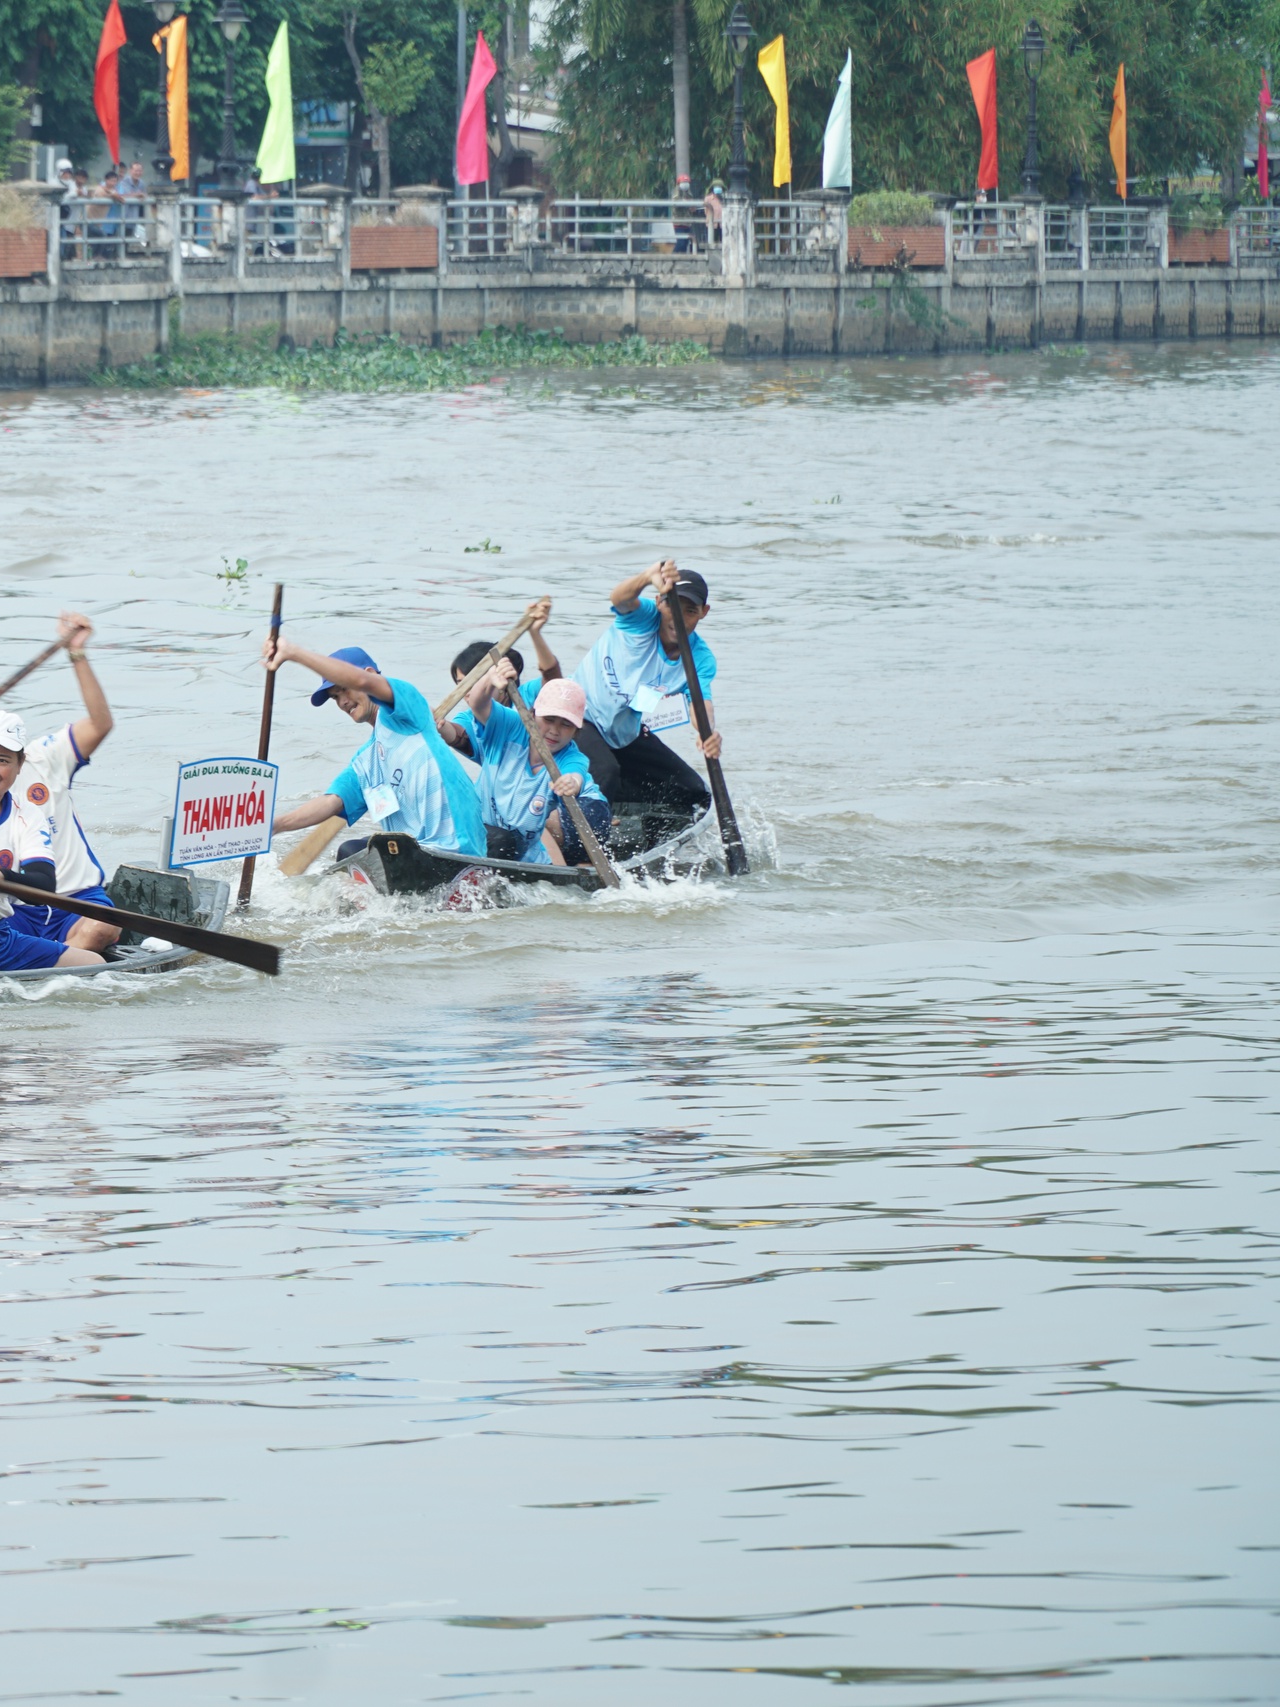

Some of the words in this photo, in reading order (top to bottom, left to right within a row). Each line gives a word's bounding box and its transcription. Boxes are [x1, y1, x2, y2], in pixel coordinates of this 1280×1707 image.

[183, 767, 200, 780] GIẢI
[202, 766, 219, 776] ĐUA
[251, 767, 262, 776] BA
[263, 768, 274, 779] LÁ
[184, 795, 234, 841] THẠNH
[234, 780, 265, 828] HÓA
